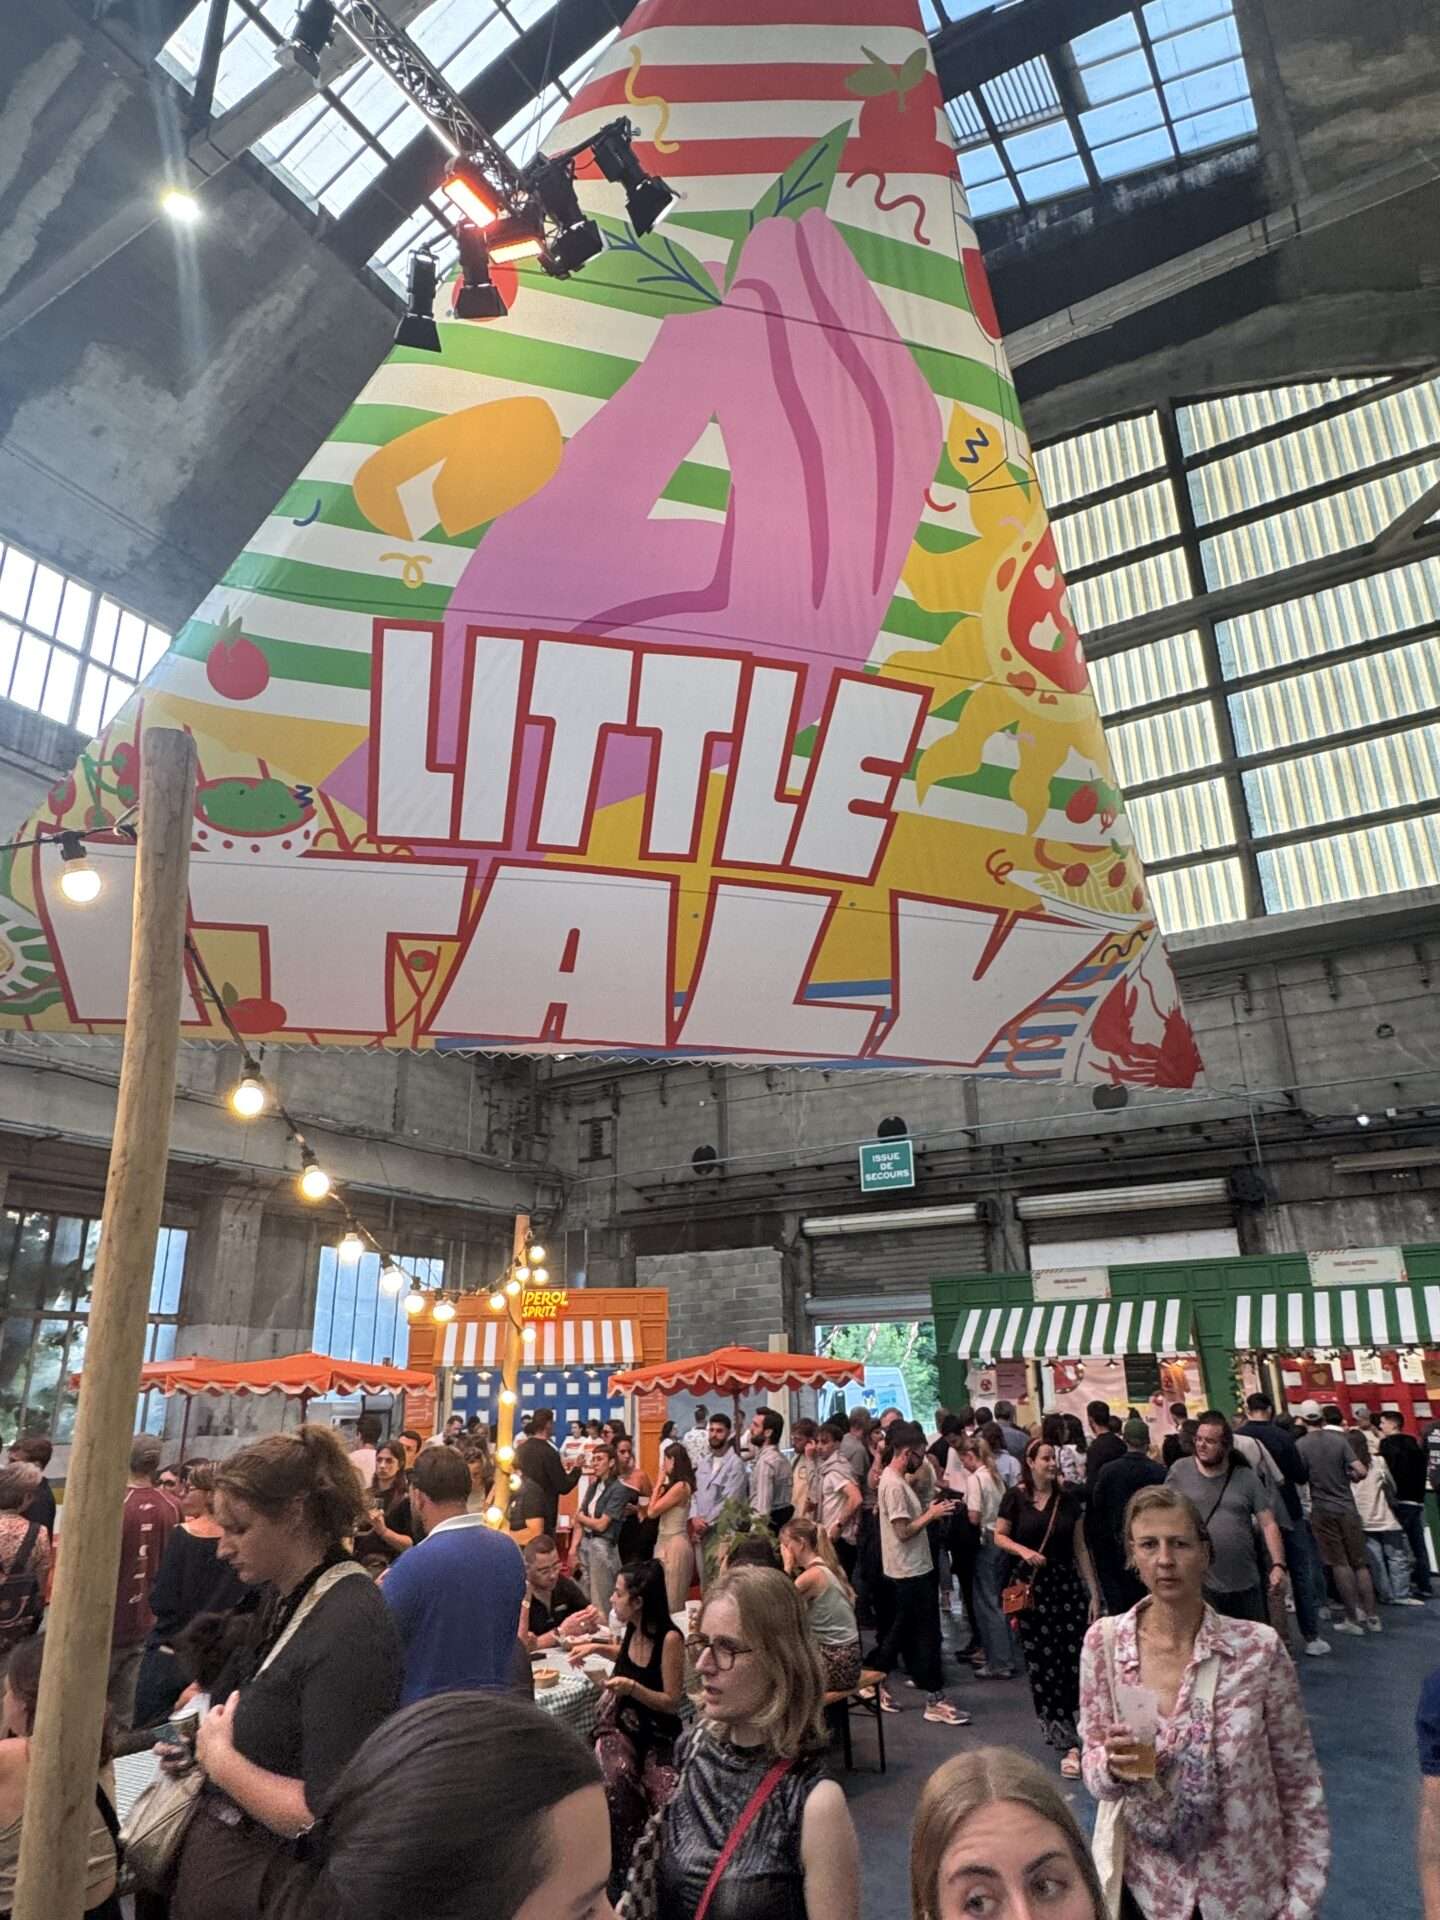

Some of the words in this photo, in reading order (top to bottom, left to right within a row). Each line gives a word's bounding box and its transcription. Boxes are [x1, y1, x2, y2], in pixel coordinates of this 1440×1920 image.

[368, 616, 935, 886] LITTLE
[34, 820, 1114, 1067] ITALY
[872, 1152, 900, 1162] ISSUE
[880, 1162, 894, 1170] DE
[865, 1169, 910, 1181] SECOURS
[521, 1306, 557, 1318] SPRITZ
